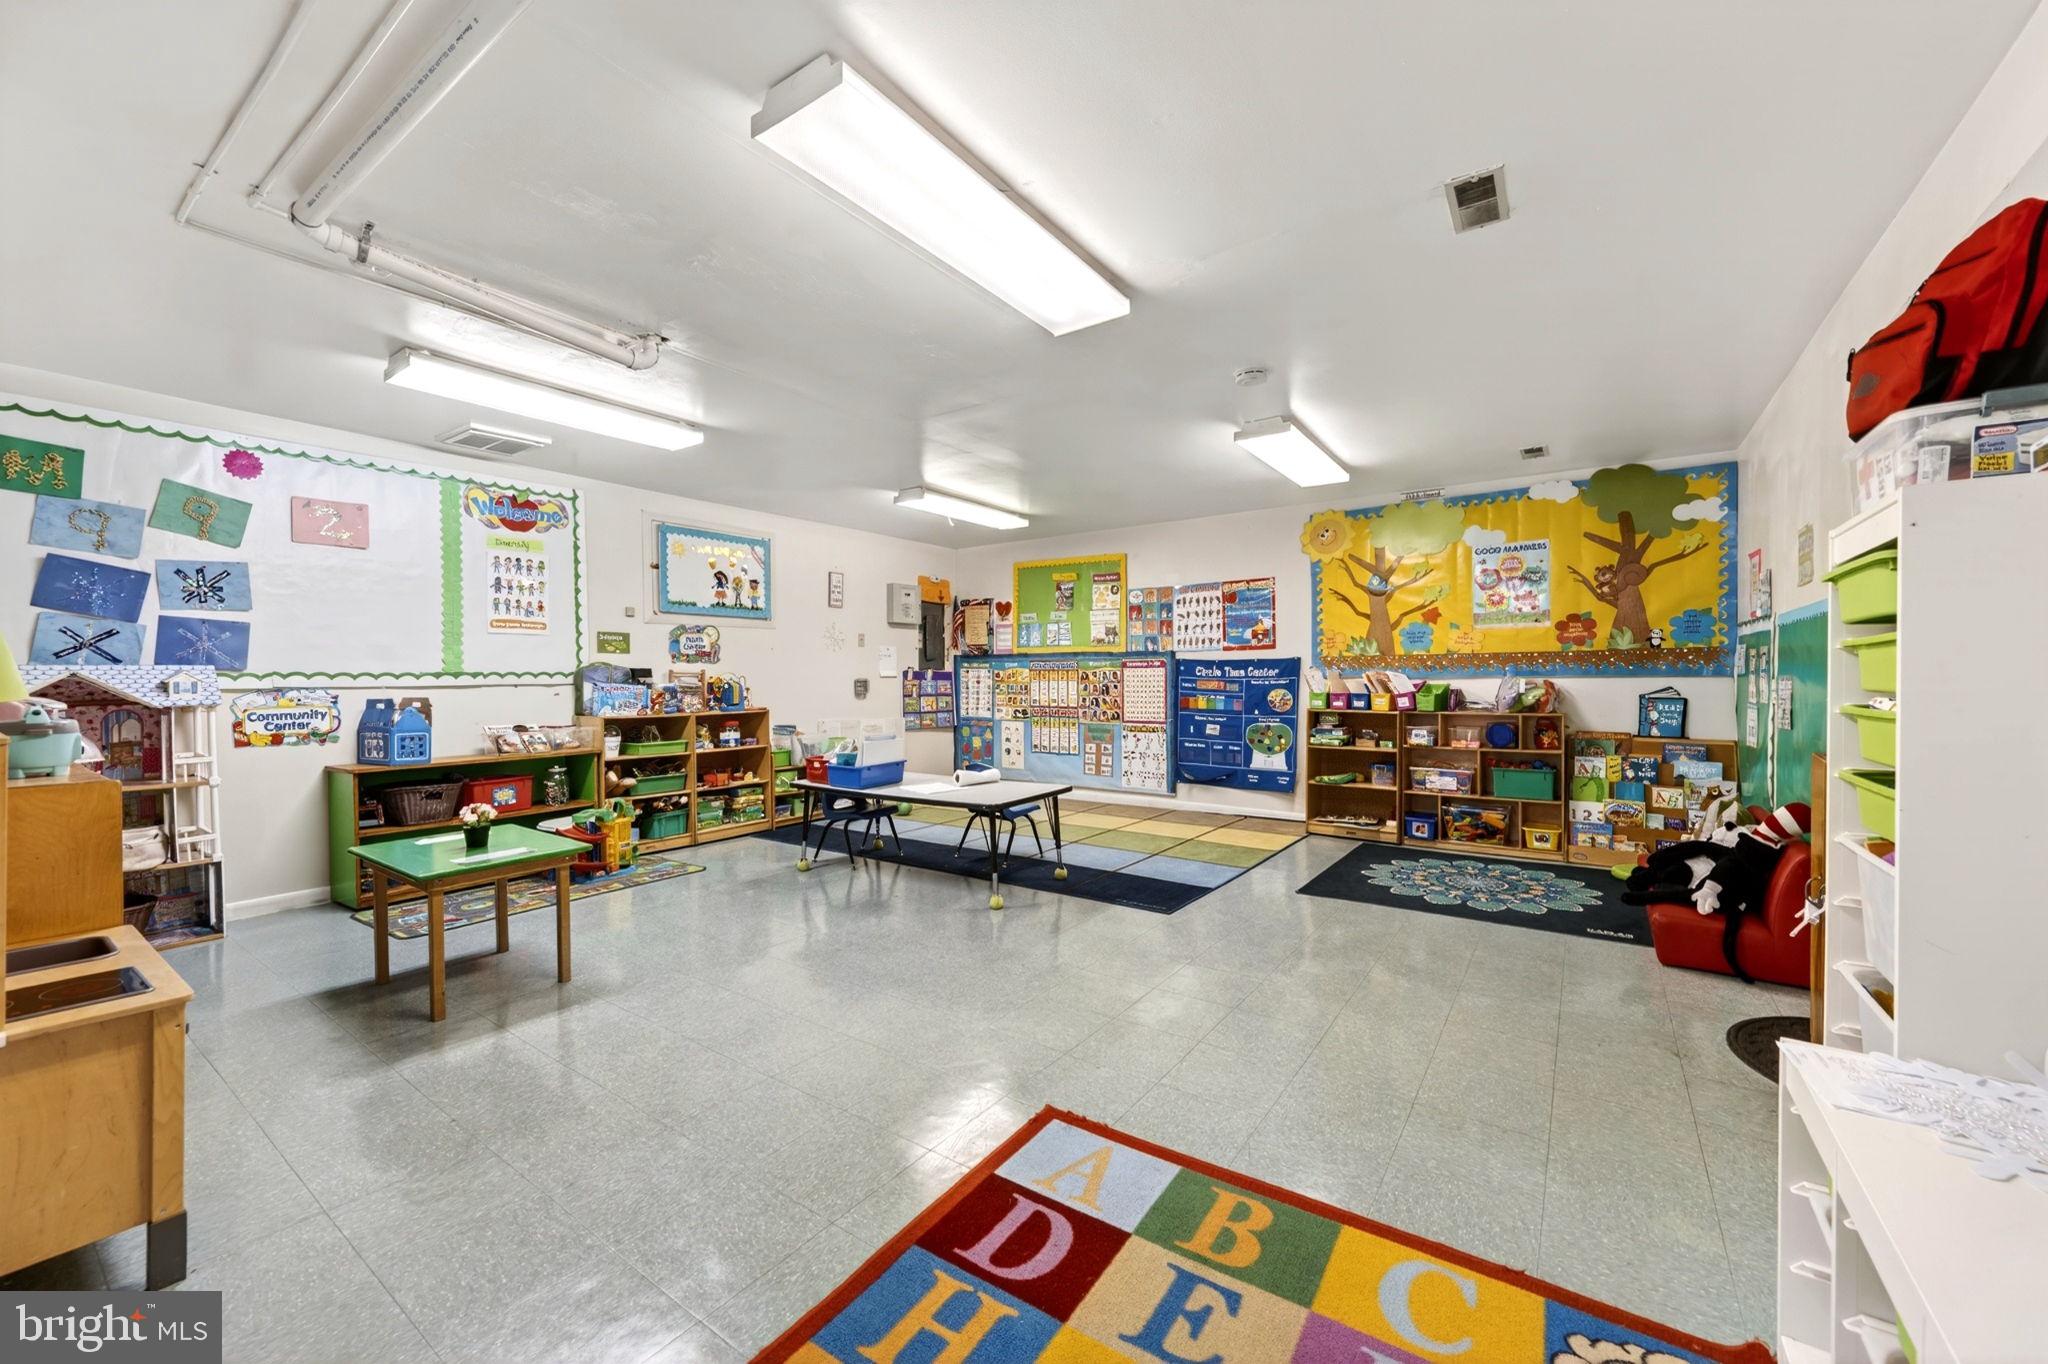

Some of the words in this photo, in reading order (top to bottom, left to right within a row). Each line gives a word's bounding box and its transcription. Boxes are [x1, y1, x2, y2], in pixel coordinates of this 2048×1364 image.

[470, 494, 564, 524] Welcome
[247, 709, 329, 723] Community
[263, 721, 312, 732] Center
[1032, 1145, 1114, 1212] A
[952, 1192, 1074, 1281] D
[1173, 1186, 1275, 1269] B
[855, 1268, 1021, 1364] H
[1118, 1261, 1244, 1364] E
[1377, 1259, 1478, 1357] C
